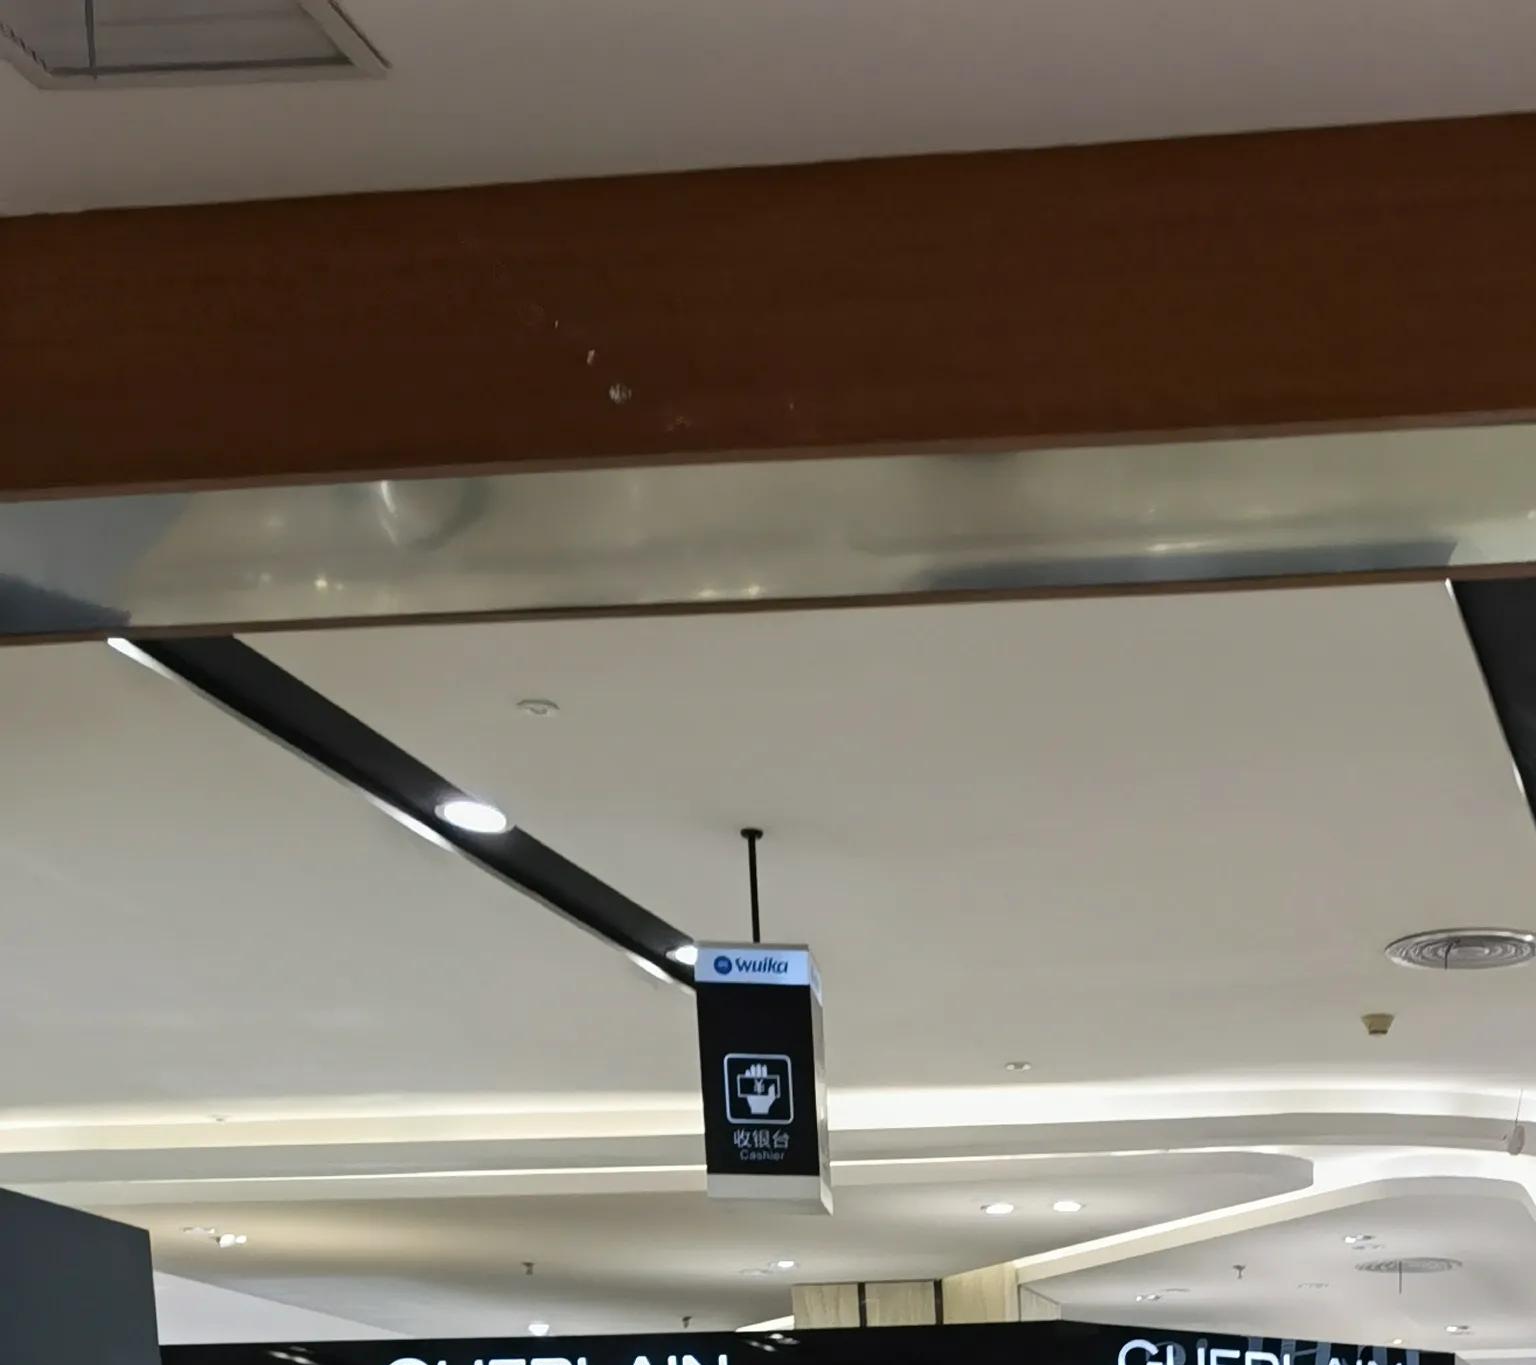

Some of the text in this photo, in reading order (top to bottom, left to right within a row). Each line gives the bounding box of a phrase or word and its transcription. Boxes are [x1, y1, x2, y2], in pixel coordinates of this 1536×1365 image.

[733, 1129, 790, 1149] 收银台
[739, 1150, 785, 1161] Cashier
